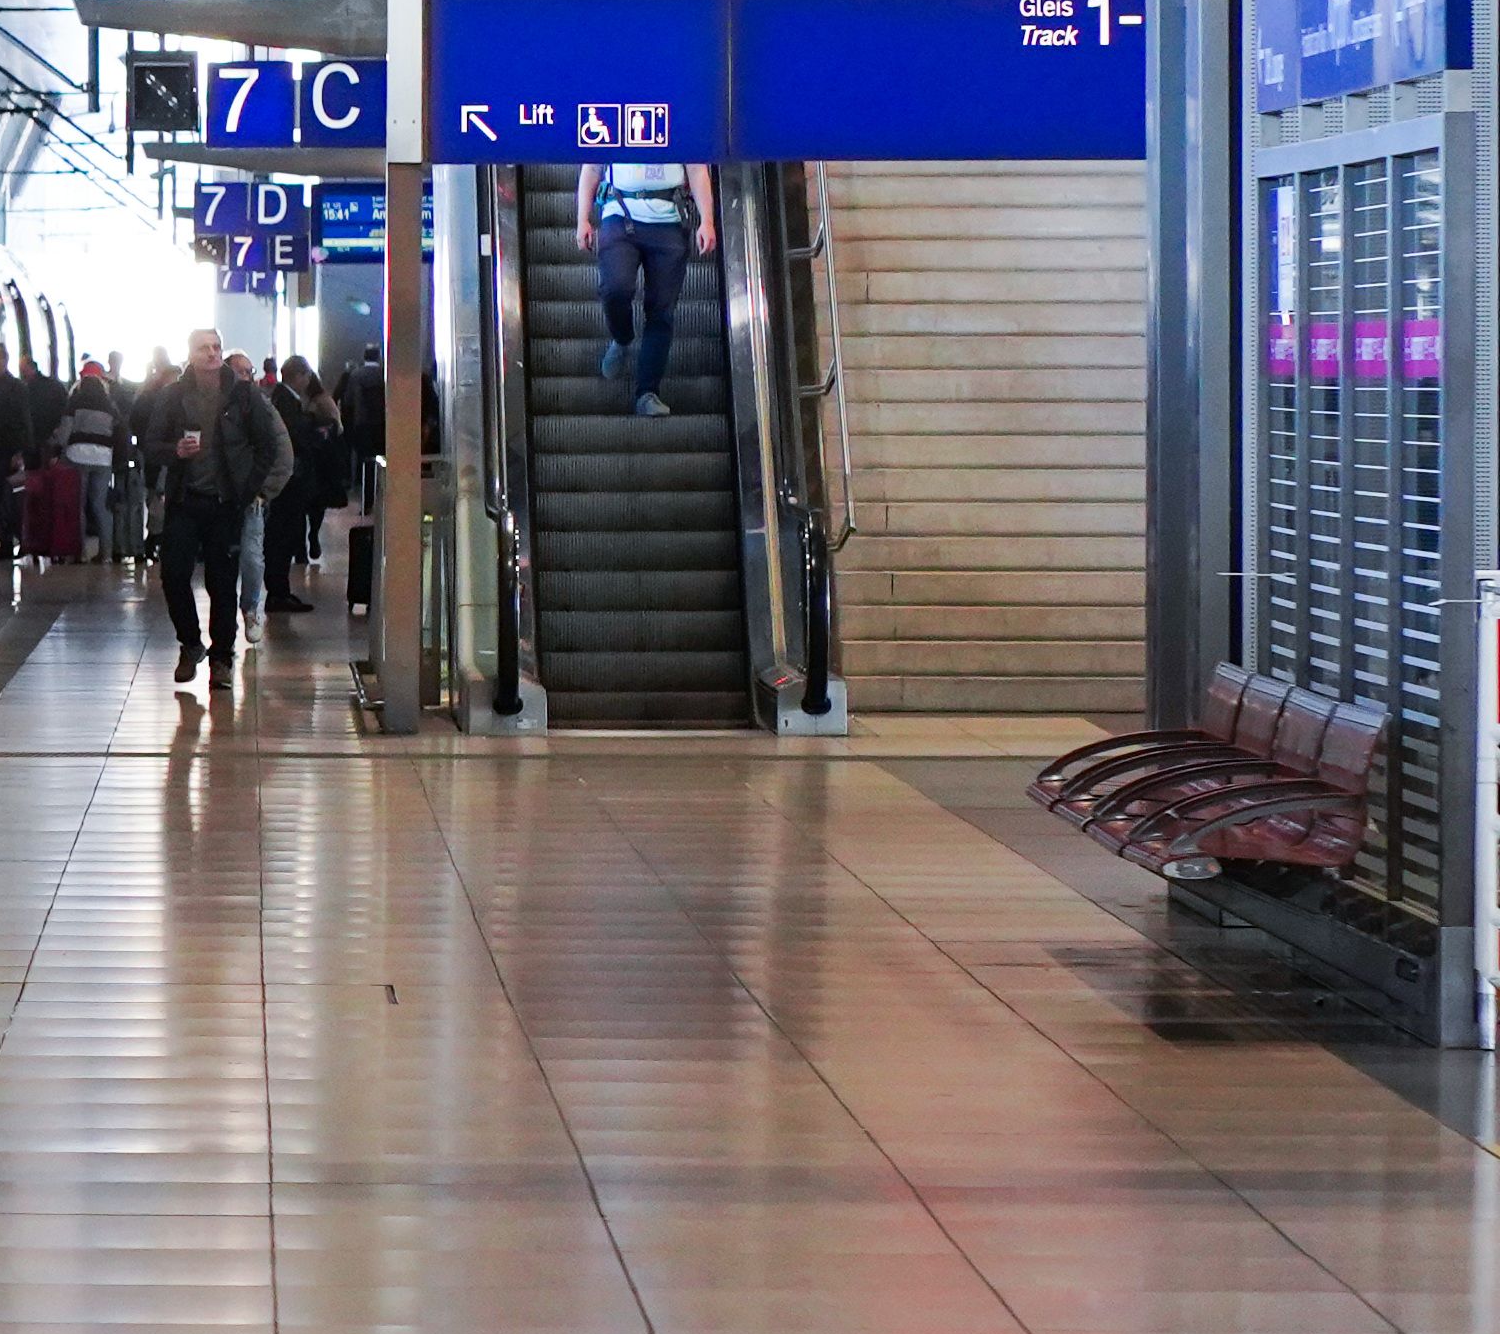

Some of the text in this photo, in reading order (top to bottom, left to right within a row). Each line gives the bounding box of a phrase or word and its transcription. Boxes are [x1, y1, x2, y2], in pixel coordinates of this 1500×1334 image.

[1020, 24, 1079, 46] Track
[218, 62, 361, 133] 7 C
[519, 103, 554, 125] Lift
[201, 184, 288, 226] 7 D
[233, 235, 294, 267] 7 E
[220, 265, 233, 290] 7
